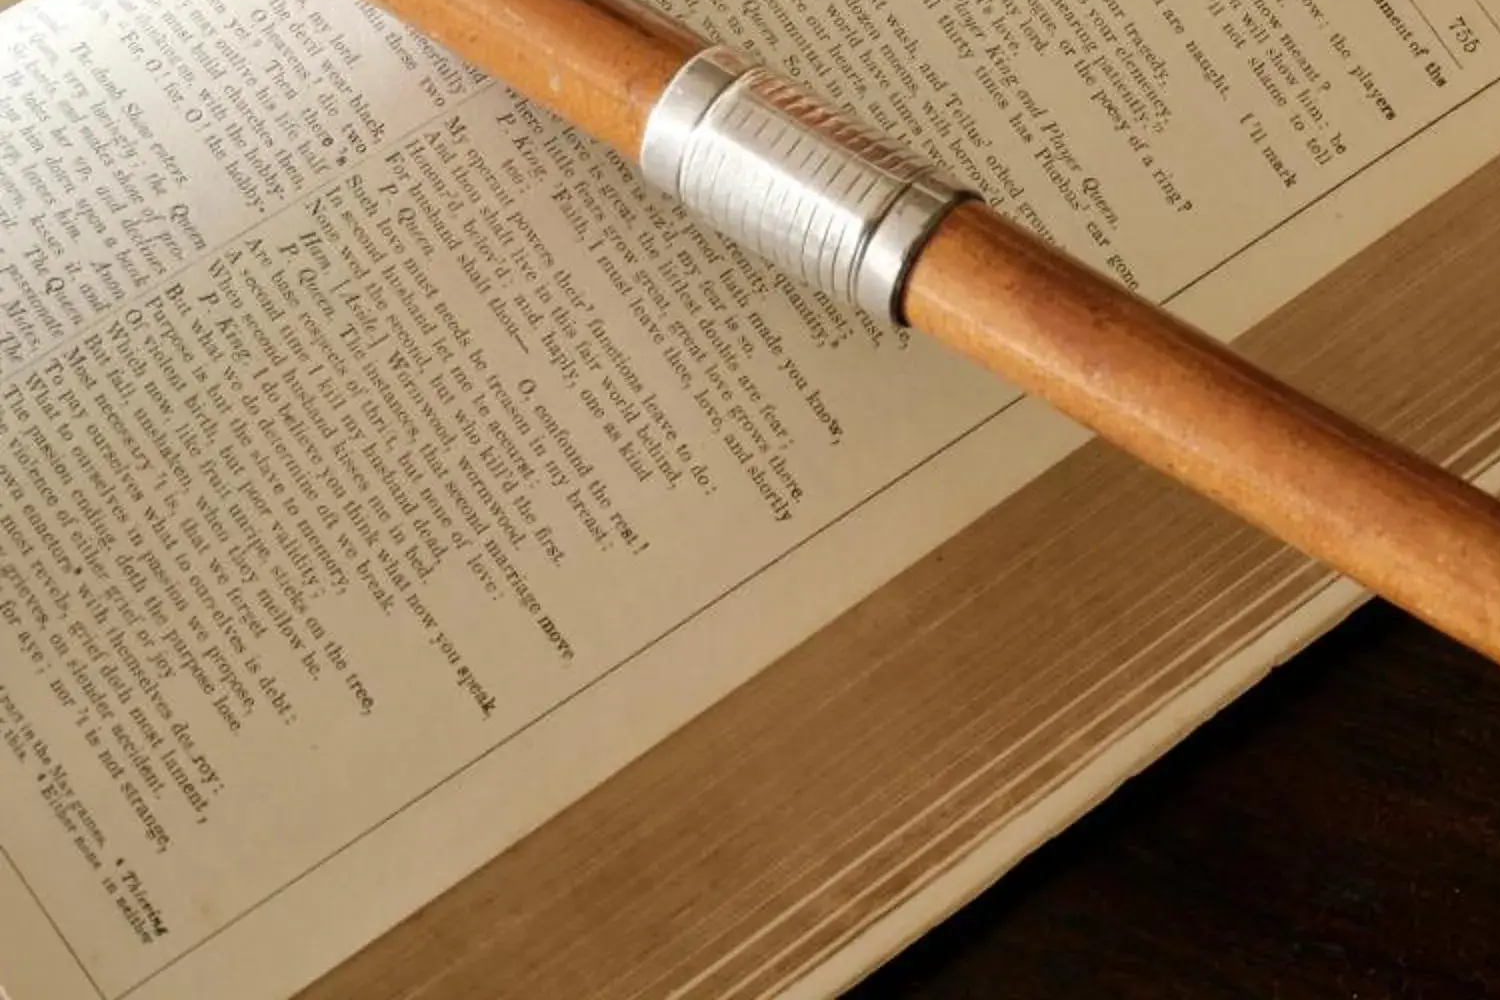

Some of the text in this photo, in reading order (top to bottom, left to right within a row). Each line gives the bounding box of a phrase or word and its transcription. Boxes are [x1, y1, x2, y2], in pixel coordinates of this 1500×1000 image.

[1329, 32, 1351, 58] the
[1348, 65, 1397, 121] players
[1448, 15, 1481, 54] 755
[1073, 58, 1097, 85] the
[1090, 88, 1131, 131] poesy
[1222, 23, 1247, 49] not
[1247, 57, 1288, 107] shame
[1306, 137, 1334, 166] tell
[680, 222, 844, 445] proof hath made you know,
[534, 405, 595, 478] confound
[588, 479, 612, 507] the
[667, 320, 804, 504] great love grows there.
[483, 539, 574, 659] marriage move
[323, 641, 374, 715] the tree,
[405, 592, 496, 718] now you speak,
[97, 749, 171, 854] not strange,
